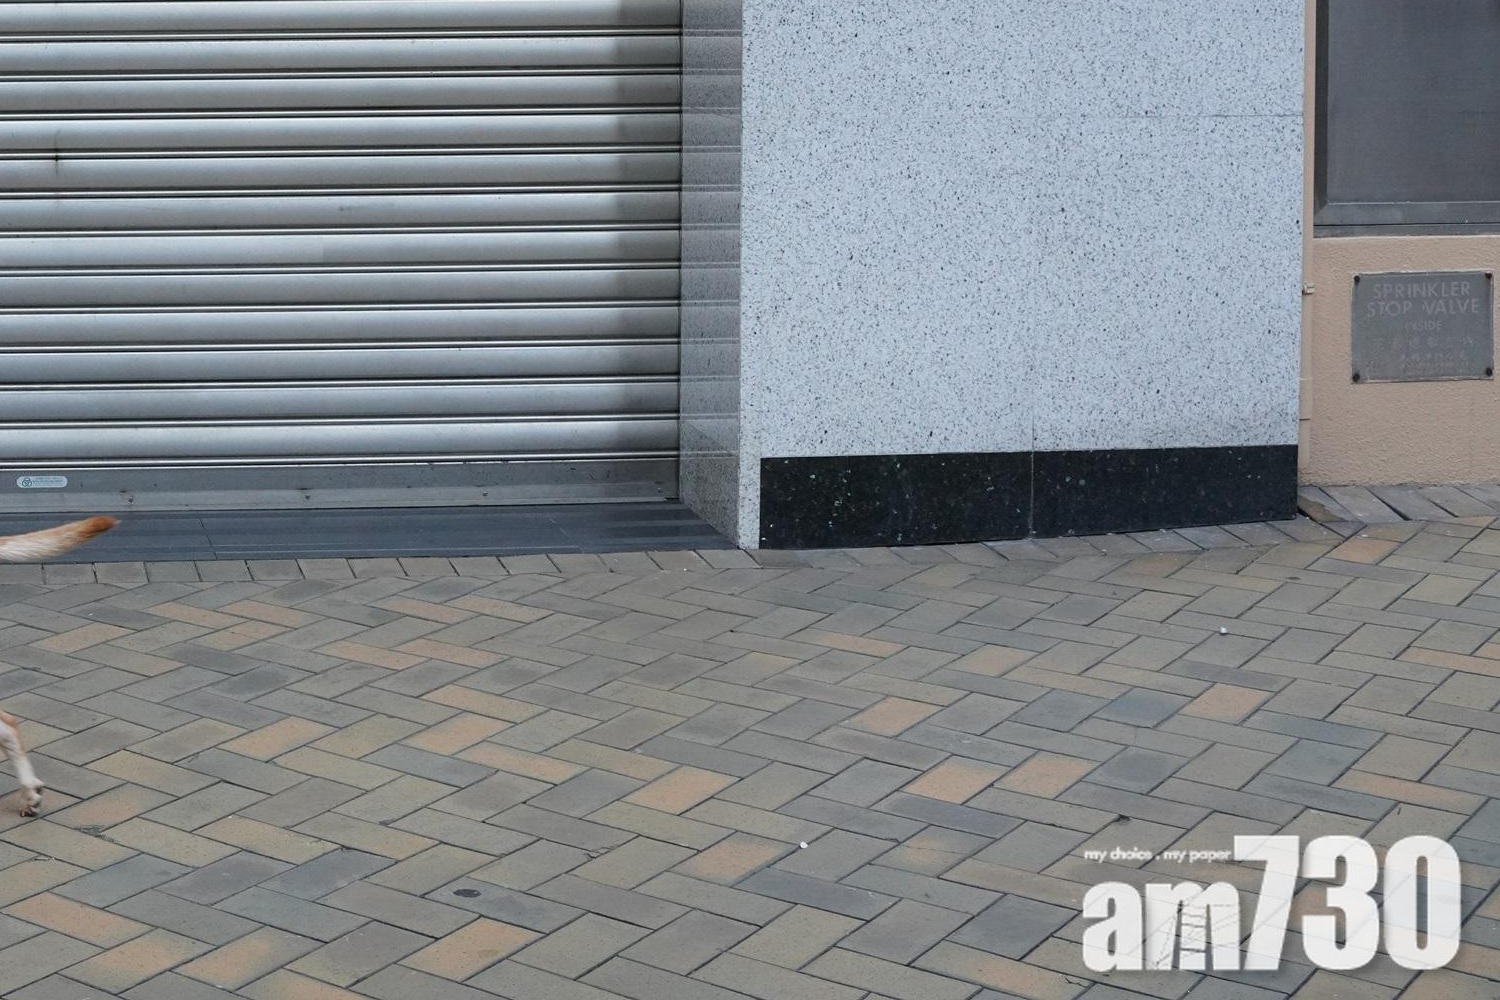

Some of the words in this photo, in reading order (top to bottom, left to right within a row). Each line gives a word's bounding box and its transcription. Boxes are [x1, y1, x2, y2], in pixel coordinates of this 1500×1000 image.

[1373, 281, 1470, 299] SPRINKLER
[1367, 300, 1412, 317] STOP
[1422, 298, 1480, 315] VALVE
